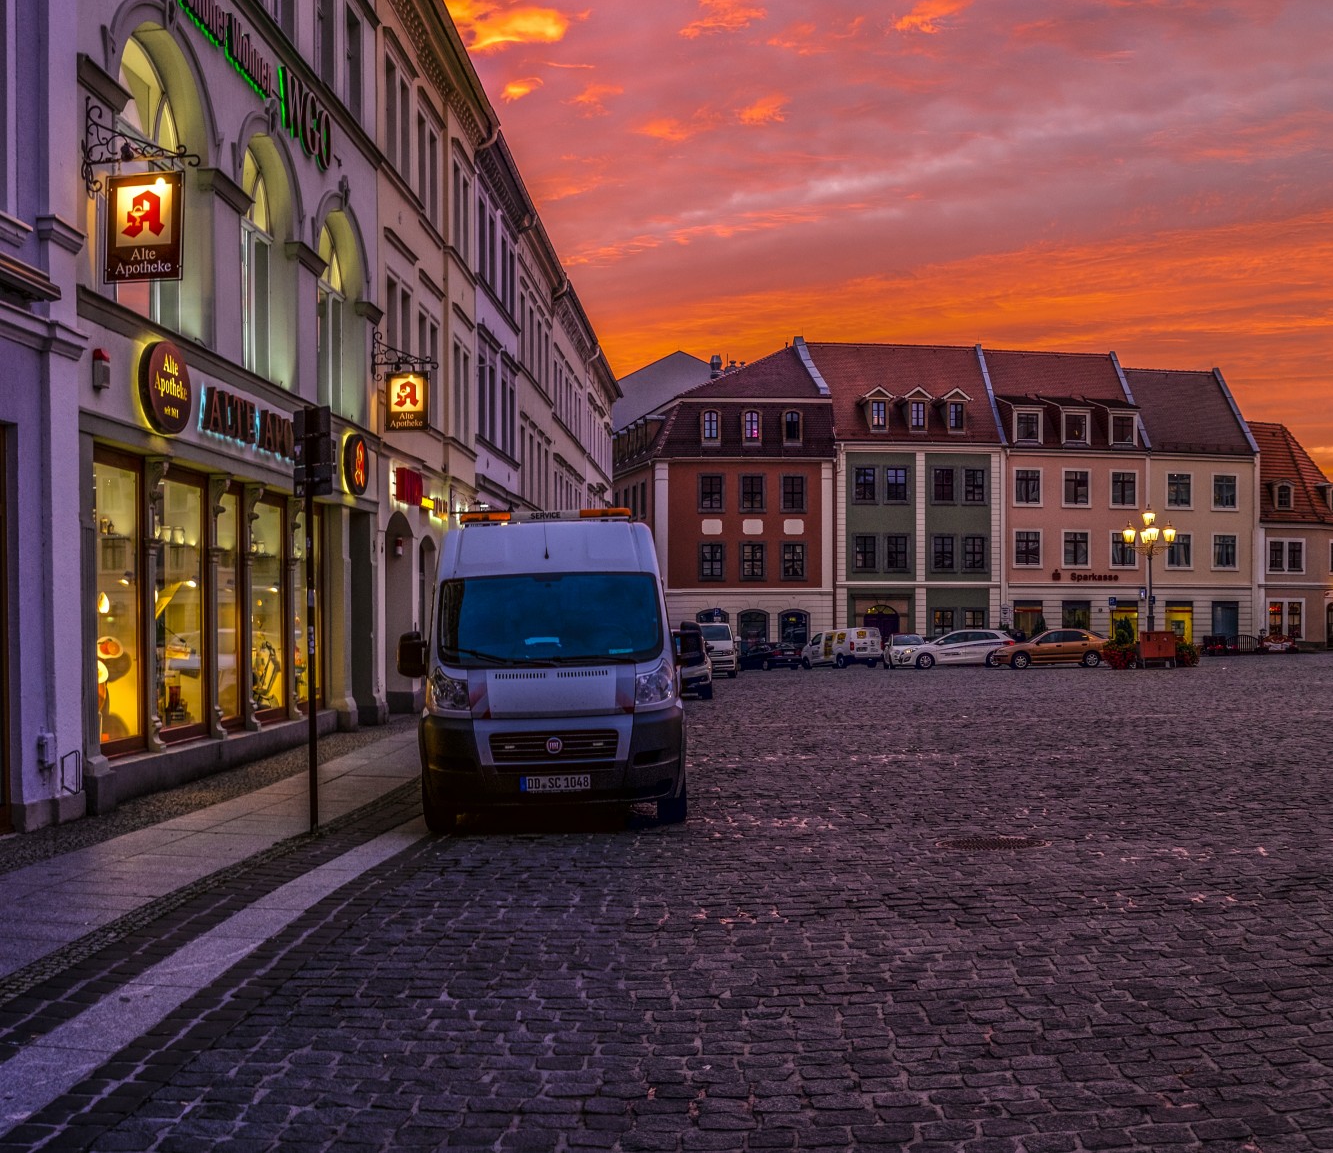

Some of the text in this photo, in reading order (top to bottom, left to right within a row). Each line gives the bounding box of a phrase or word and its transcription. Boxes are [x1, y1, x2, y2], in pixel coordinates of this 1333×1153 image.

[280, 66, 331, 168] WGO
[131, 247, 156, 261] Alte
[115, 260, 172, 277] Apotheke
[163, 353, 179, 377] Alte
[154, 370, 188, 401] Apotheke
[203, 387, 257, 444] ALTE
[399, 412, 414, 420] Alte
[390, 419, 423, 428] Apotheke
[530, 512, 561, 520] SERVICE
[1070, 572, 1119, 582] Sparkasse
[528, 776, 589, 789] DD SC 1048
